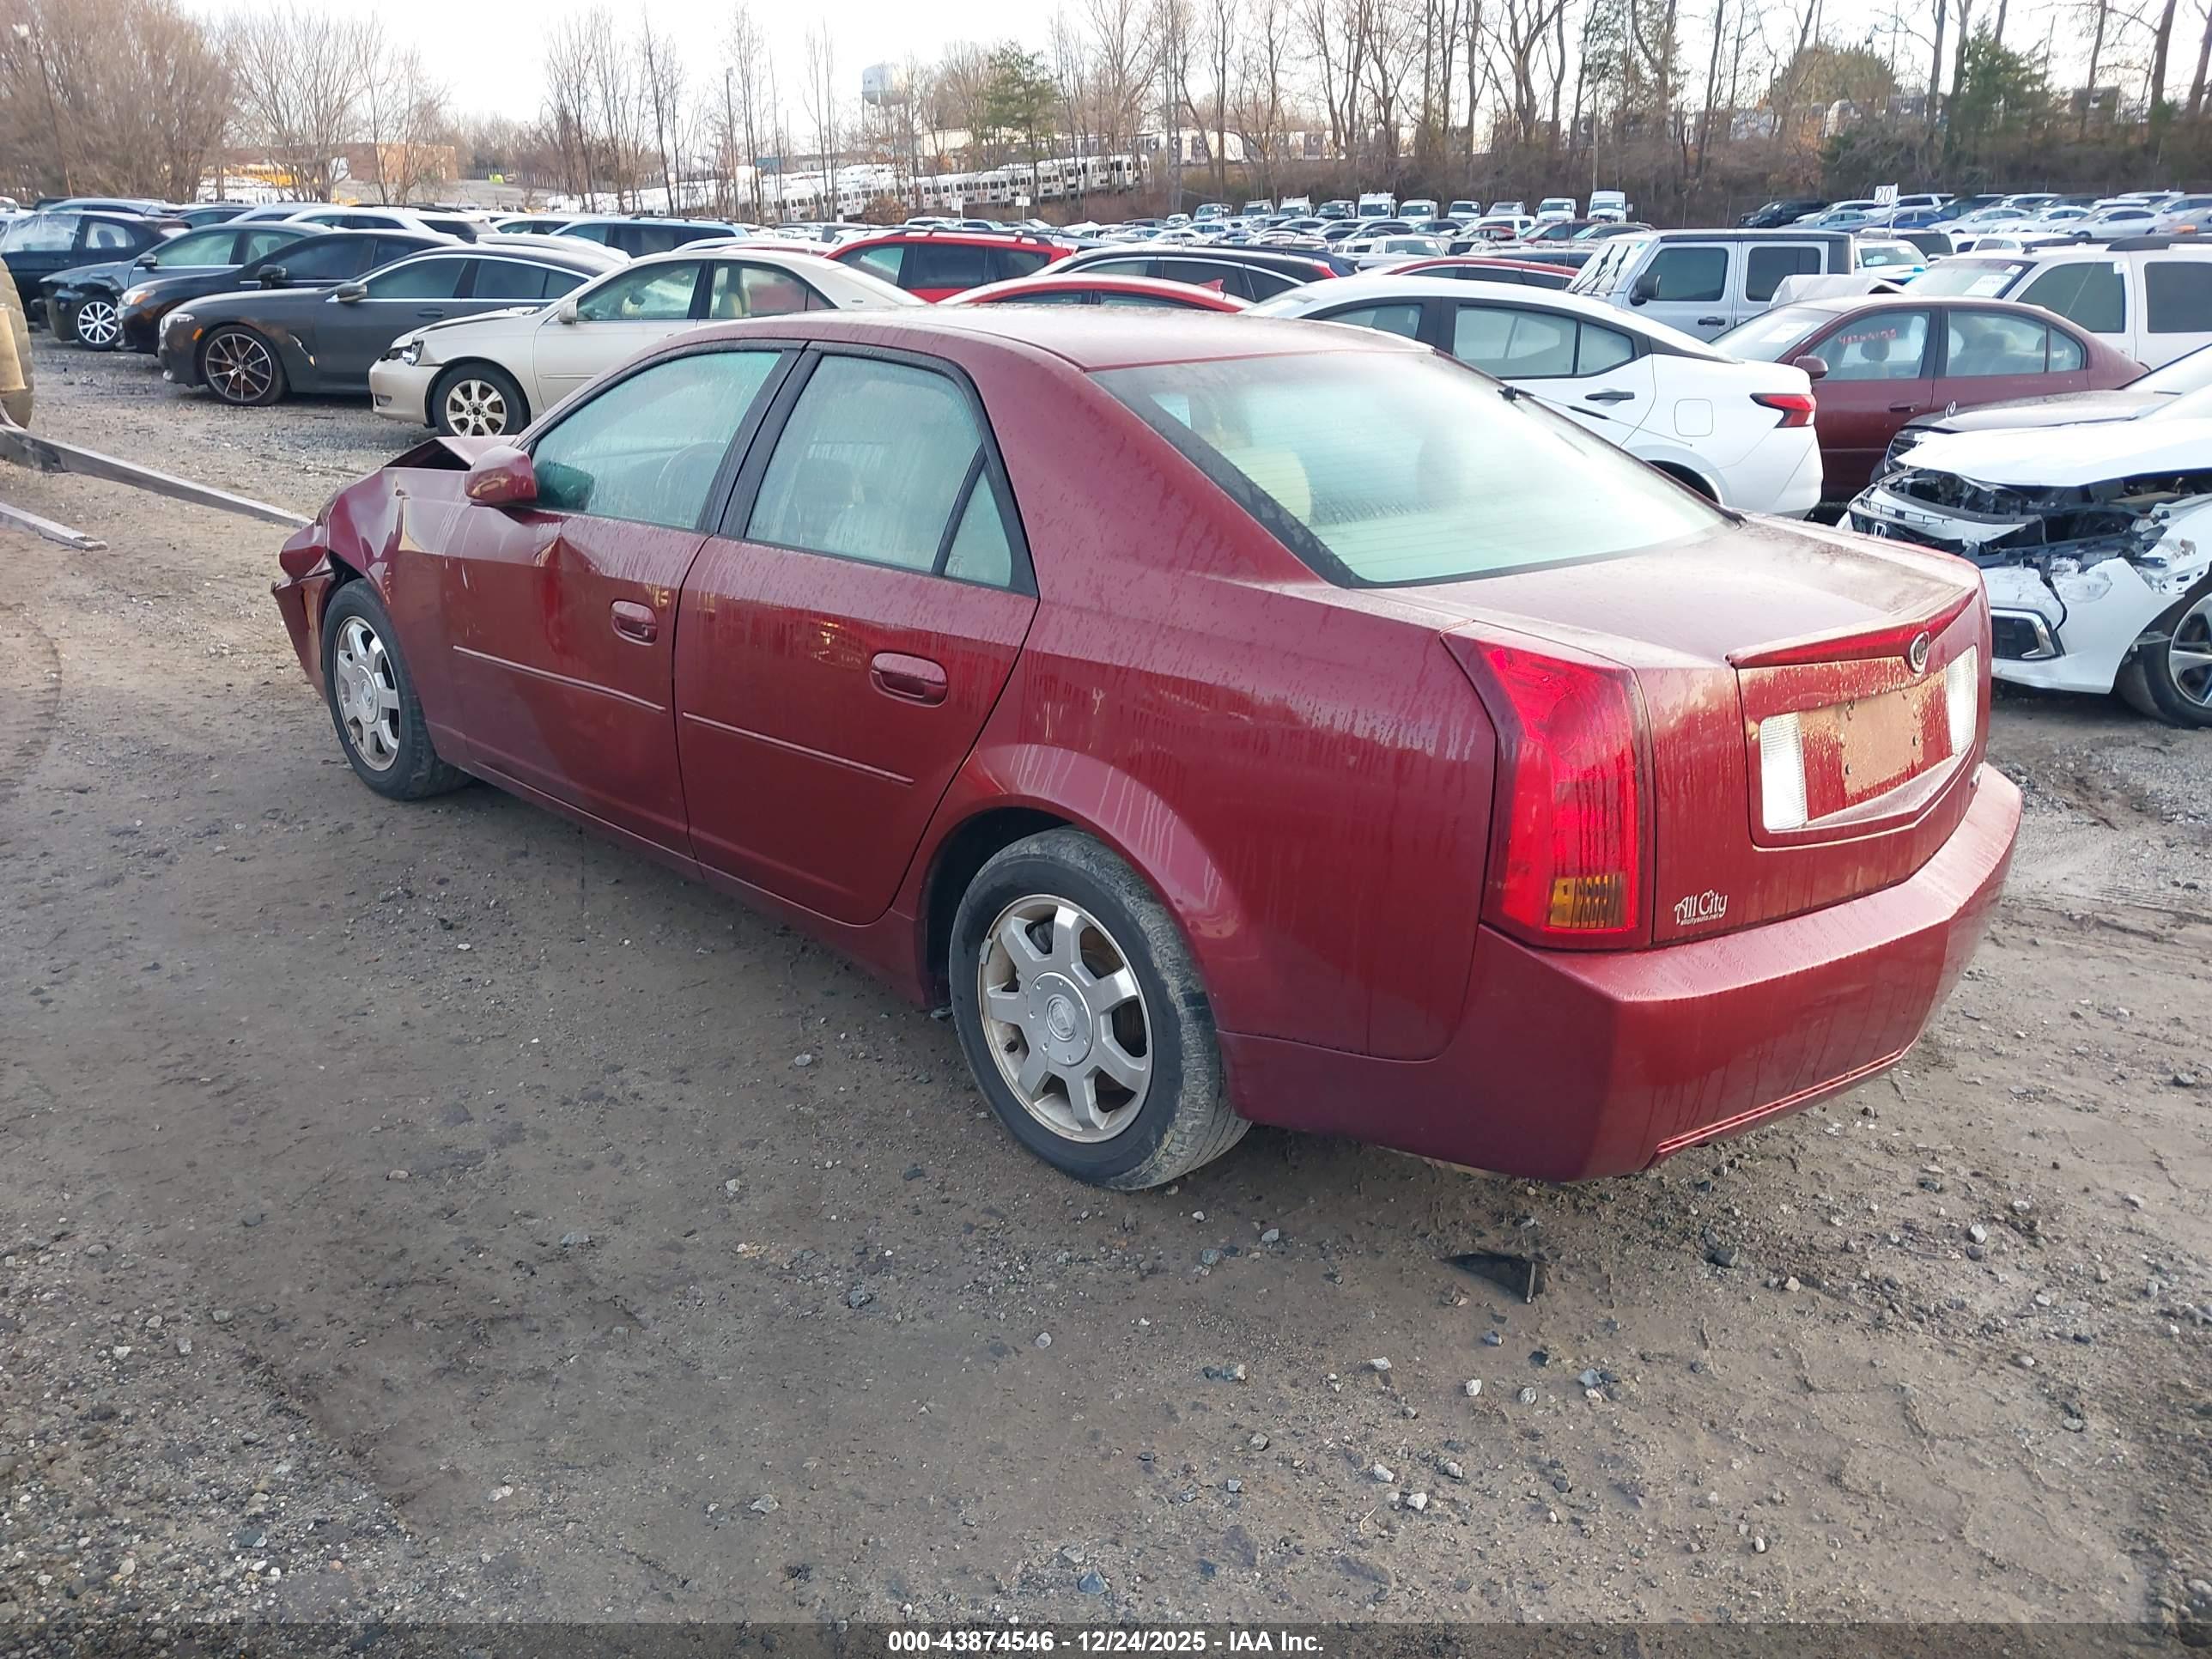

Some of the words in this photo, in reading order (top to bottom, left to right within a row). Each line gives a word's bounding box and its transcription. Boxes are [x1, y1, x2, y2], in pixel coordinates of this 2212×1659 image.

[1875, 187, 1892, 204] 20
[1674, 893, 1698, 926] All
[1699, 889, 1729, 918] City
